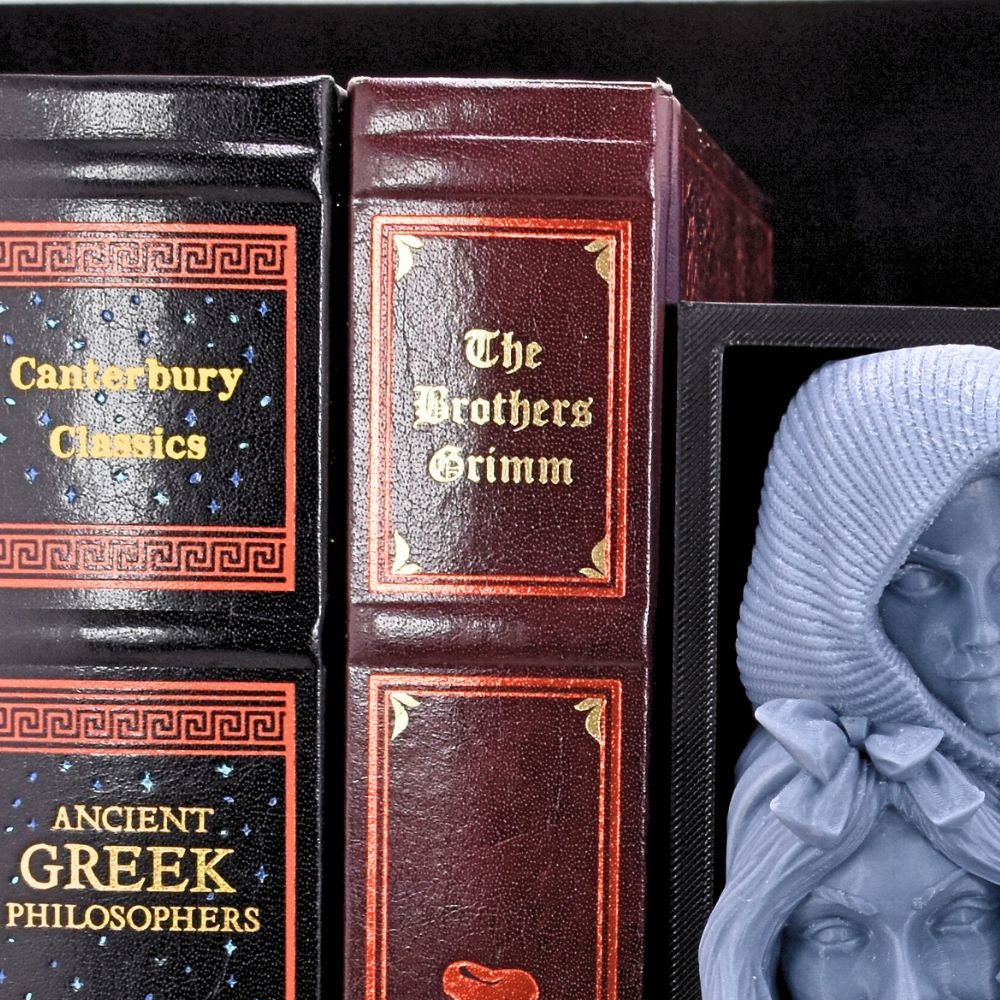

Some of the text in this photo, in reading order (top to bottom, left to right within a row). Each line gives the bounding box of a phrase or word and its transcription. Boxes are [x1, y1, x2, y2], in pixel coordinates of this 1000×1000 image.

[463, 328, 543, 374] The
[10, 356, 243, 401] Canterbury
[412, 384, 594, 432] Brothers
[49, 425, 207, 459] Classics
[428, 445, 574, 486] Grimm
[51, 804, 214, 833] ANCIENT
[20, 843, 237, 893] GREEK
[5, 902, 261, 932] PHILOSOPHERS
